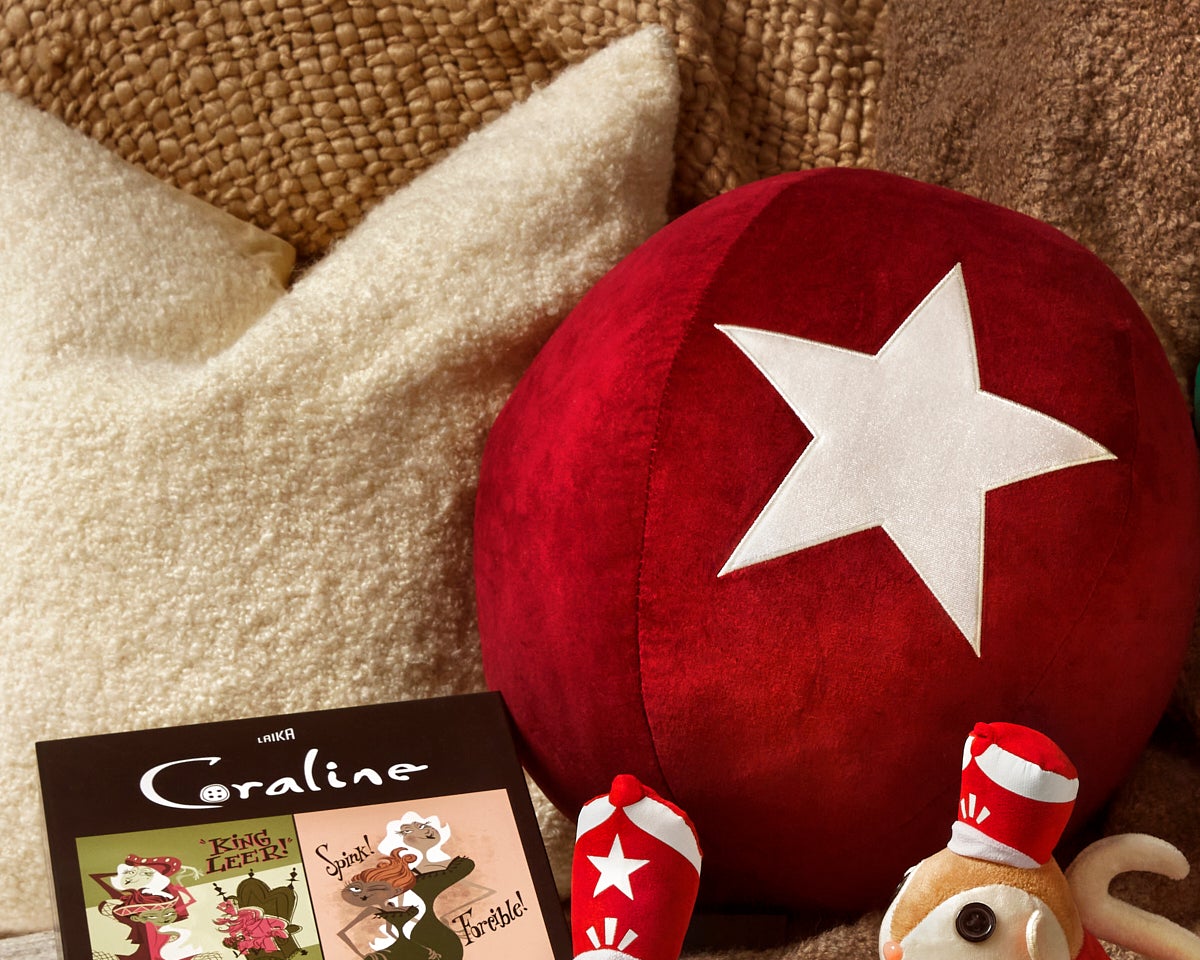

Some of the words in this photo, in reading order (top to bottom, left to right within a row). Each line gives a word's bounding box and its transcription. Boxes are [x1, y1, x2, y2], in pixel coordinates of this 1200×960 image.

[258, 727, 295, 744] LAIKA
[139, 748, 429, 809] Coraline
[315, 834, 376, 881] Spink!
[451, 891, 529, 947] Forcible!
